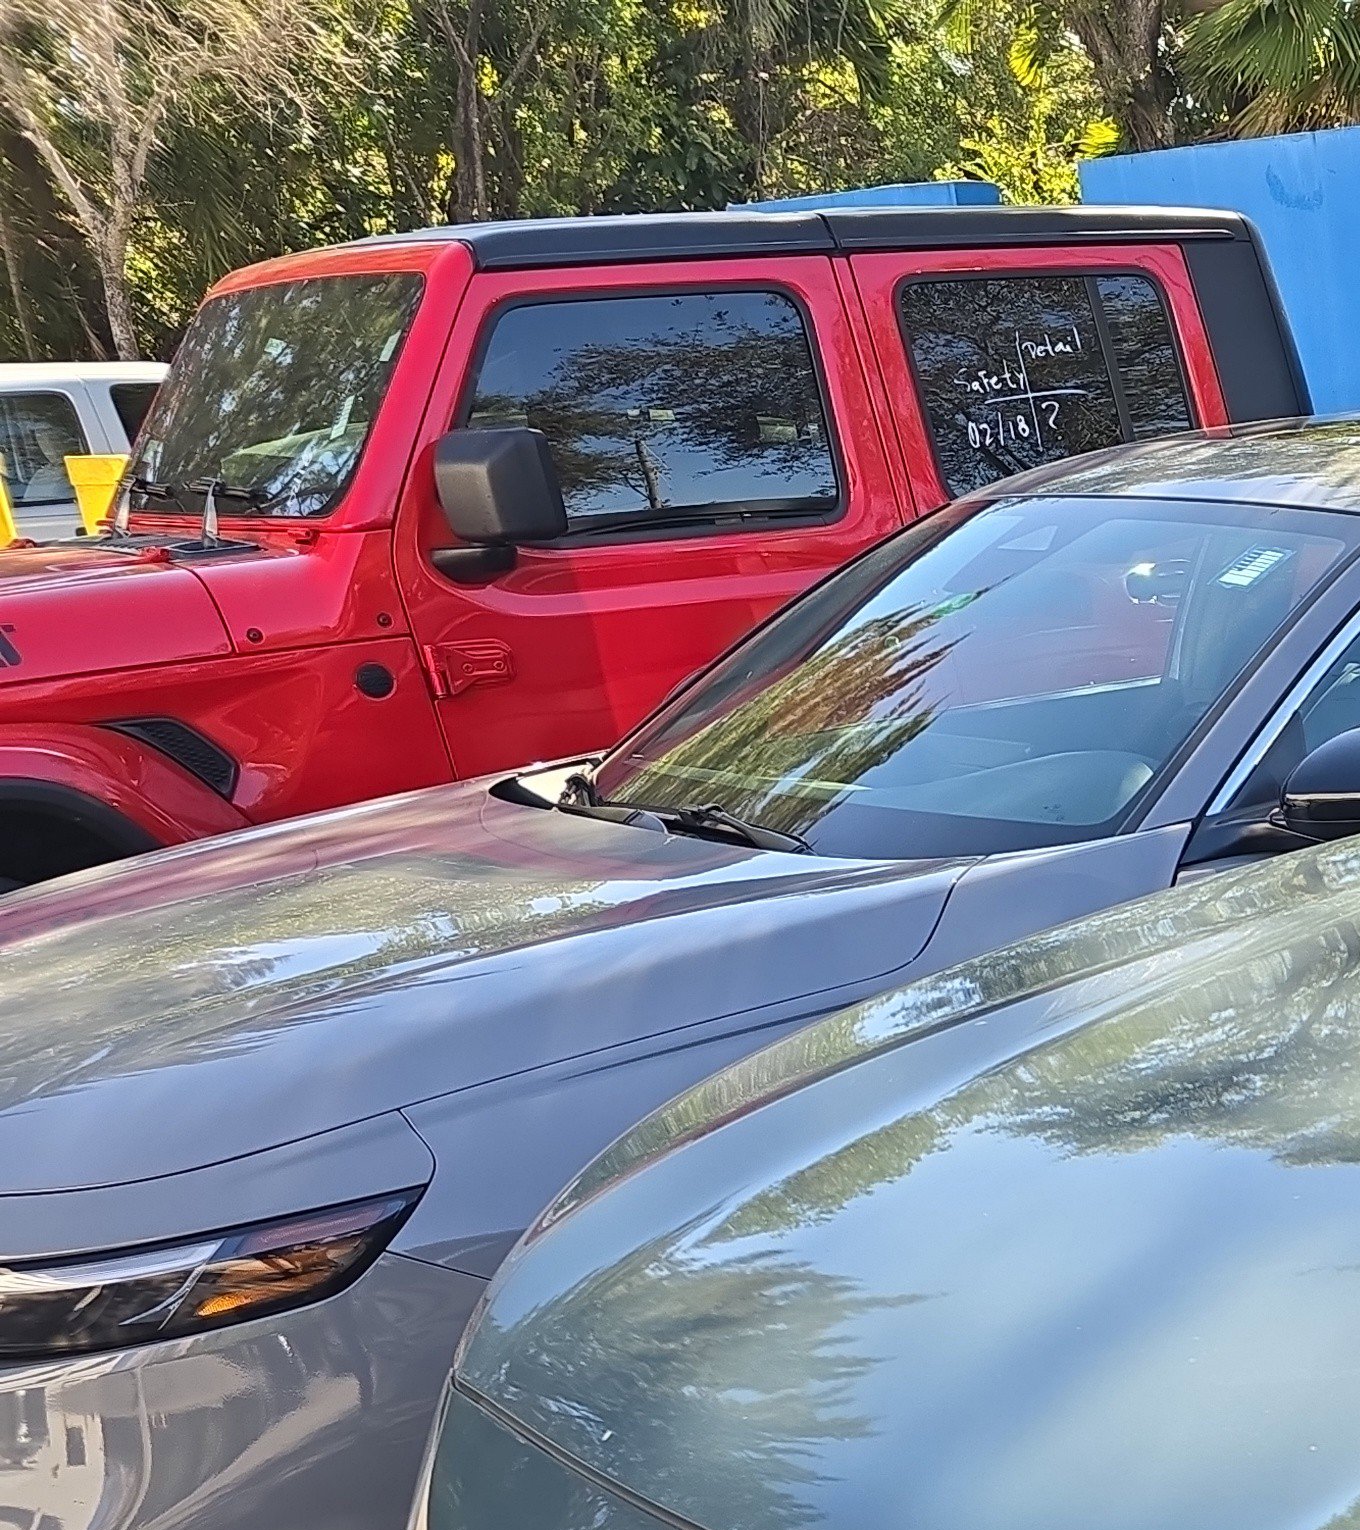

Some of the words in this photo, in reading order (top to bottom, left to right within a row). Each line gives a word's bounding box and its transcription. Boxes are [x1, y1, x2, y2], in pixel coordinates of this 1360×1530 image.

[1021, 326, 1081, 359] Detail
[968, 411, 1029, 448] 02/18
[1041, 401, 1060, 441] ?
